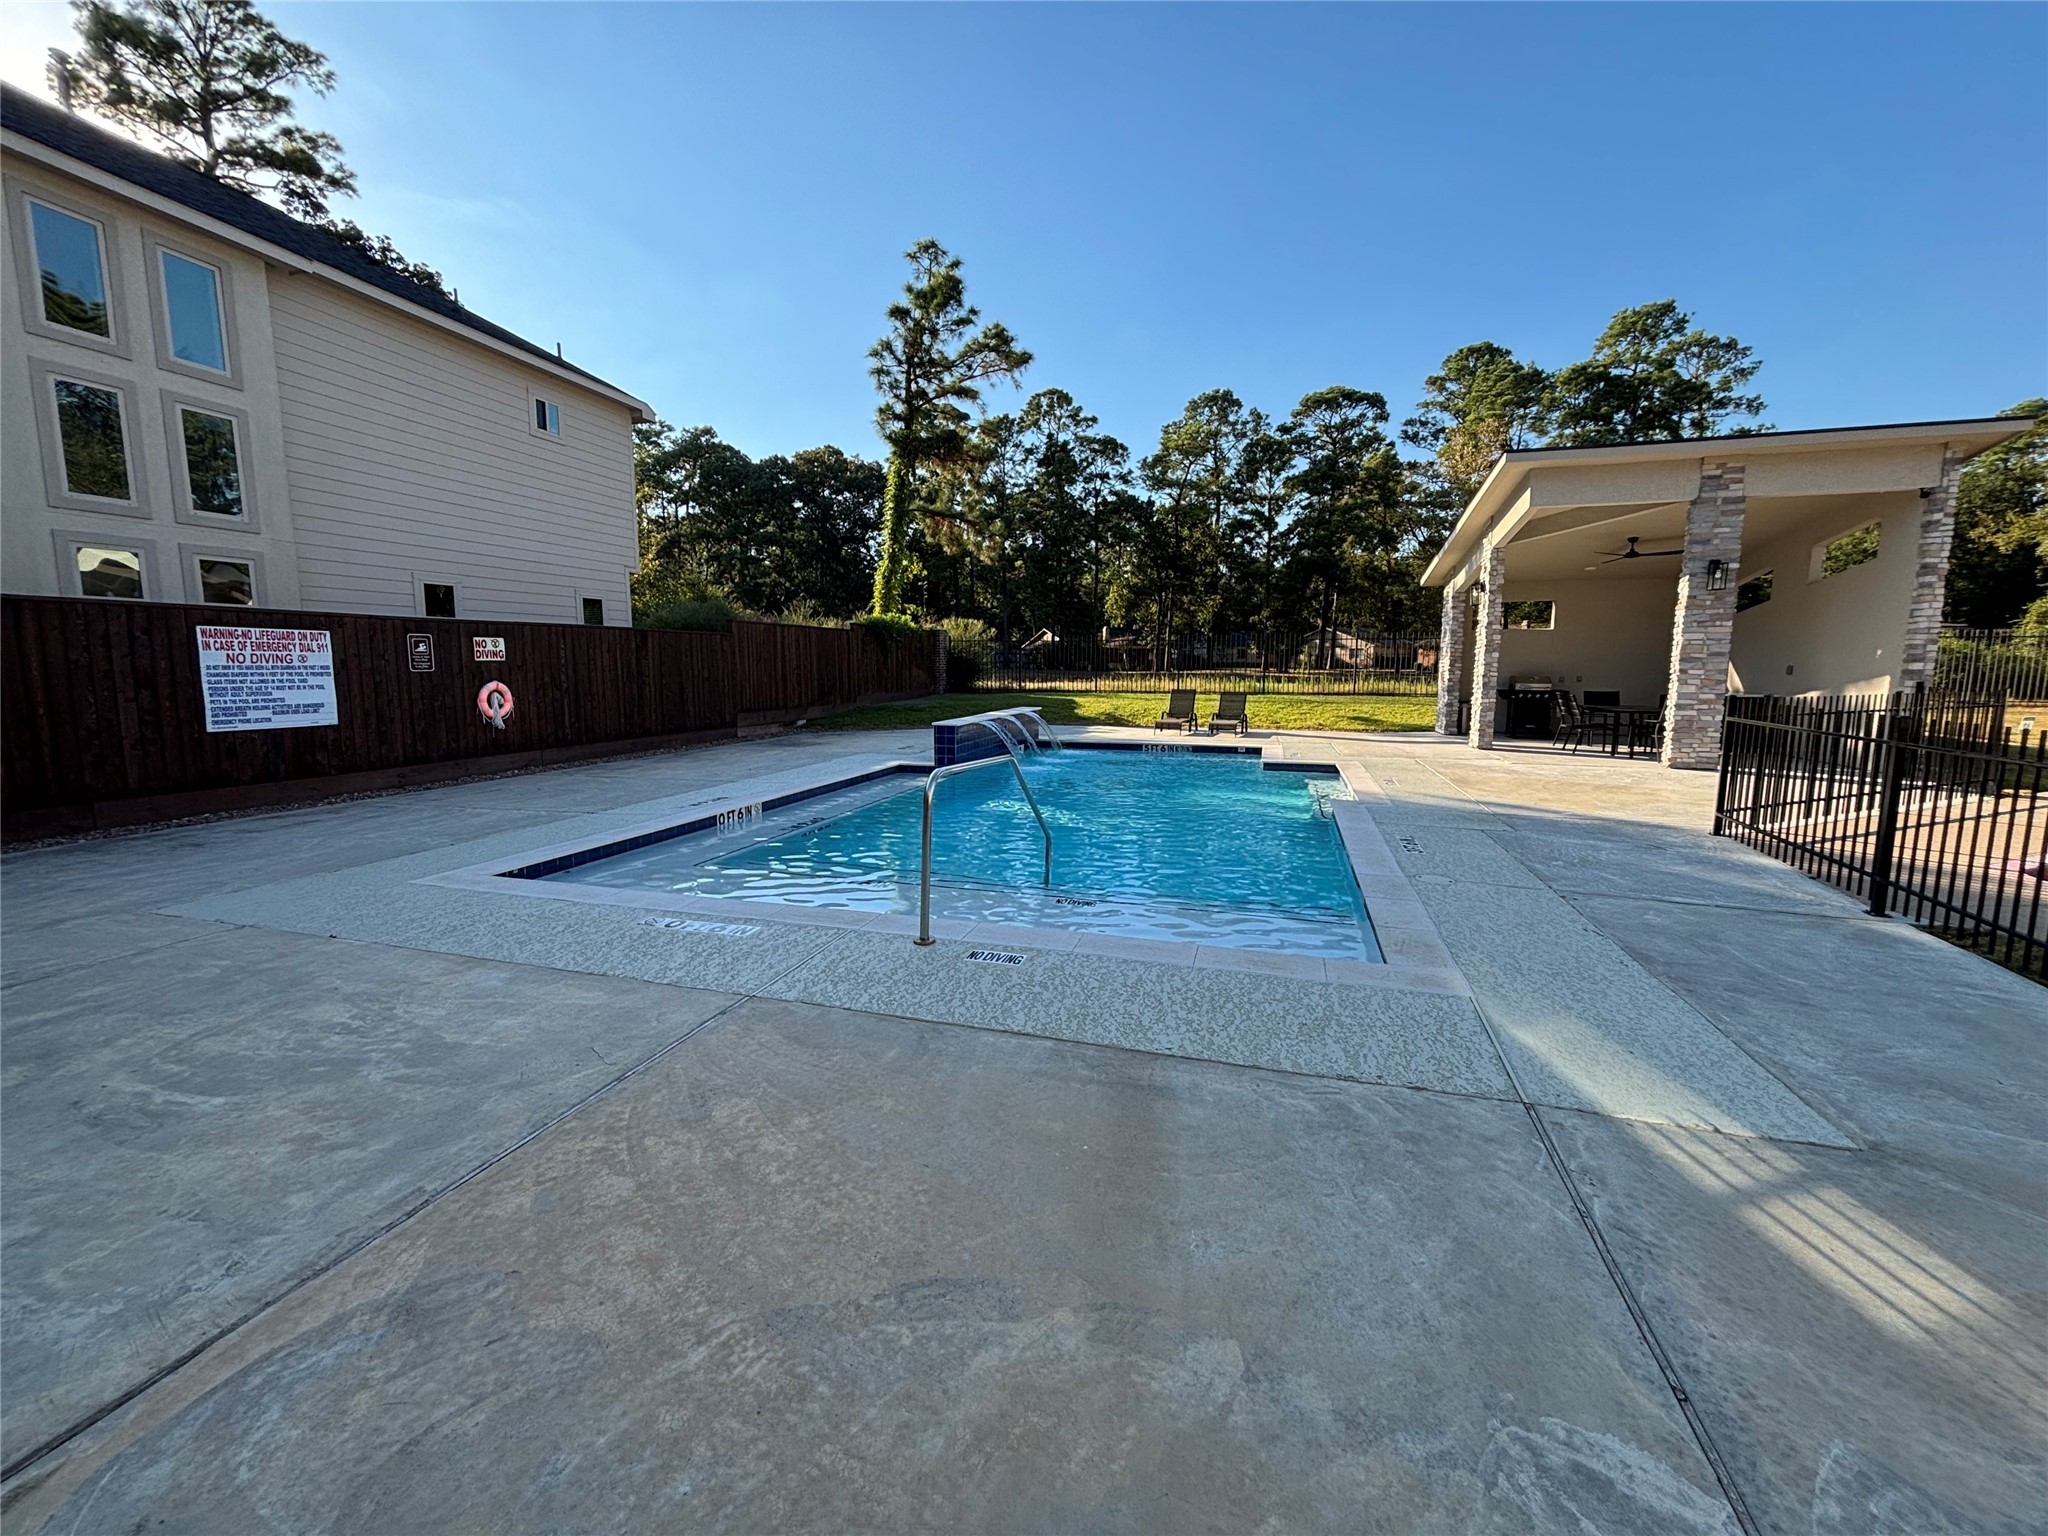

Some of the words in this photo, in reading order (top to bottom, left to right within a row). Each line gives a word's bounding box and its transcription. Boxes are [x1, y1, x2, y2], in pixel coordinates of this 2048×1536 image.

[200, 628, 252, 640] WARNING-NO
[255, 630, 296, 641] LIFEGUARD
[298, 631, 308, 642] ON
[309, 632, 328, 642] DUTY
[202, 640, 211, 651] IN
[213, 640, 236, 652] CASE
[237, 640, 248, 652] OF
[250, 641, 297, 652] EMERGENCY
[298, 642, 316, 653] DIAL
[316, 642, 329, 653] 911
[475, 639, 487, 649] NO
[226, 652, 246, 664] NO
[250, 653, 294, 664] DIVING
[476, 650, 504, 659] DIVING
[727, 810, 736, 823] FT
[738, 808, 743, 819] 6
[745, 805, 752, 818] IN
[966, 950, 985, 960] NO
[982, 952, 1024, 964] DIVING
